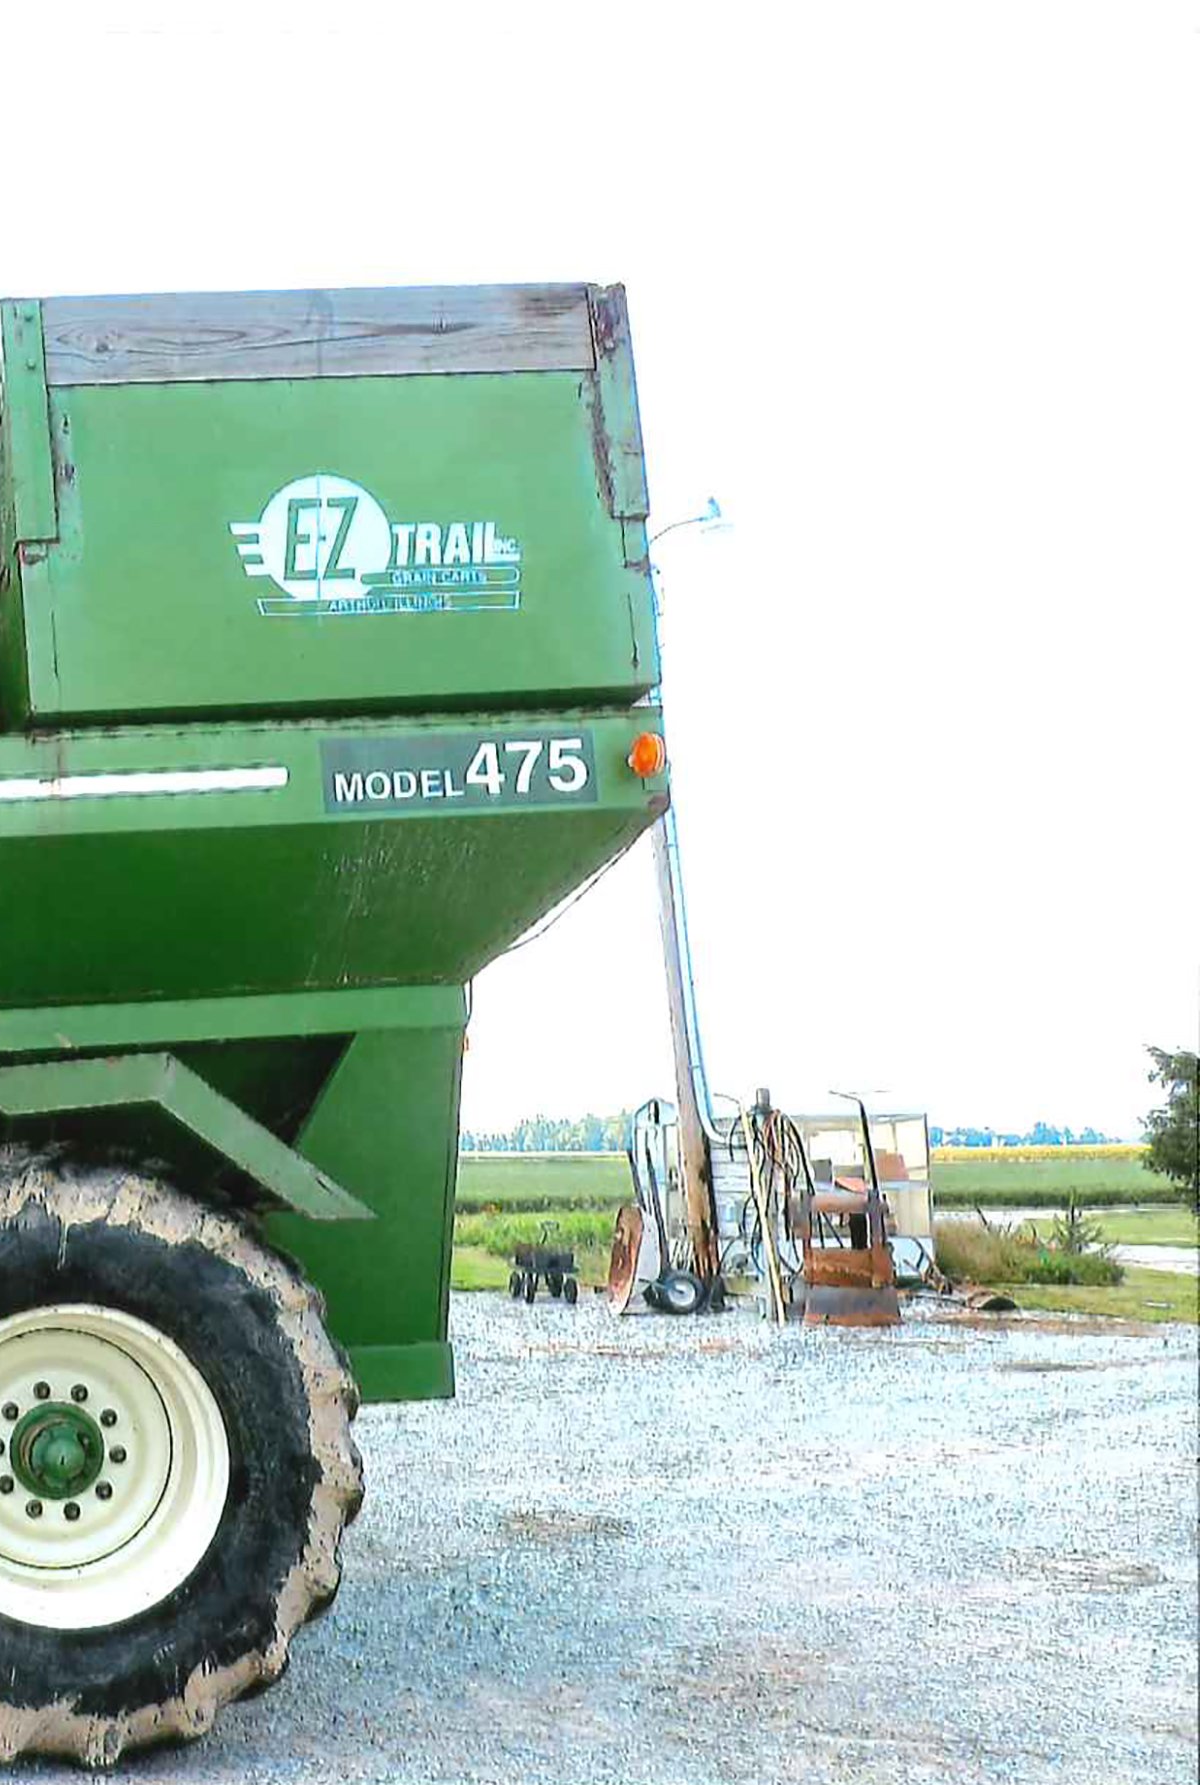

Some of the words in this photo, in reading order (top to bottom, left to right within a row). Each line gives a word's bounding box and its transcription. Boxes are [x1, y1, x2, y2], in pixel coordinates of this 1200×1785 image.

[389, 521, 520, 564] TRAIL
[334, 769, 465, 802] MODEL
[466, 738, 589, 795] 475
